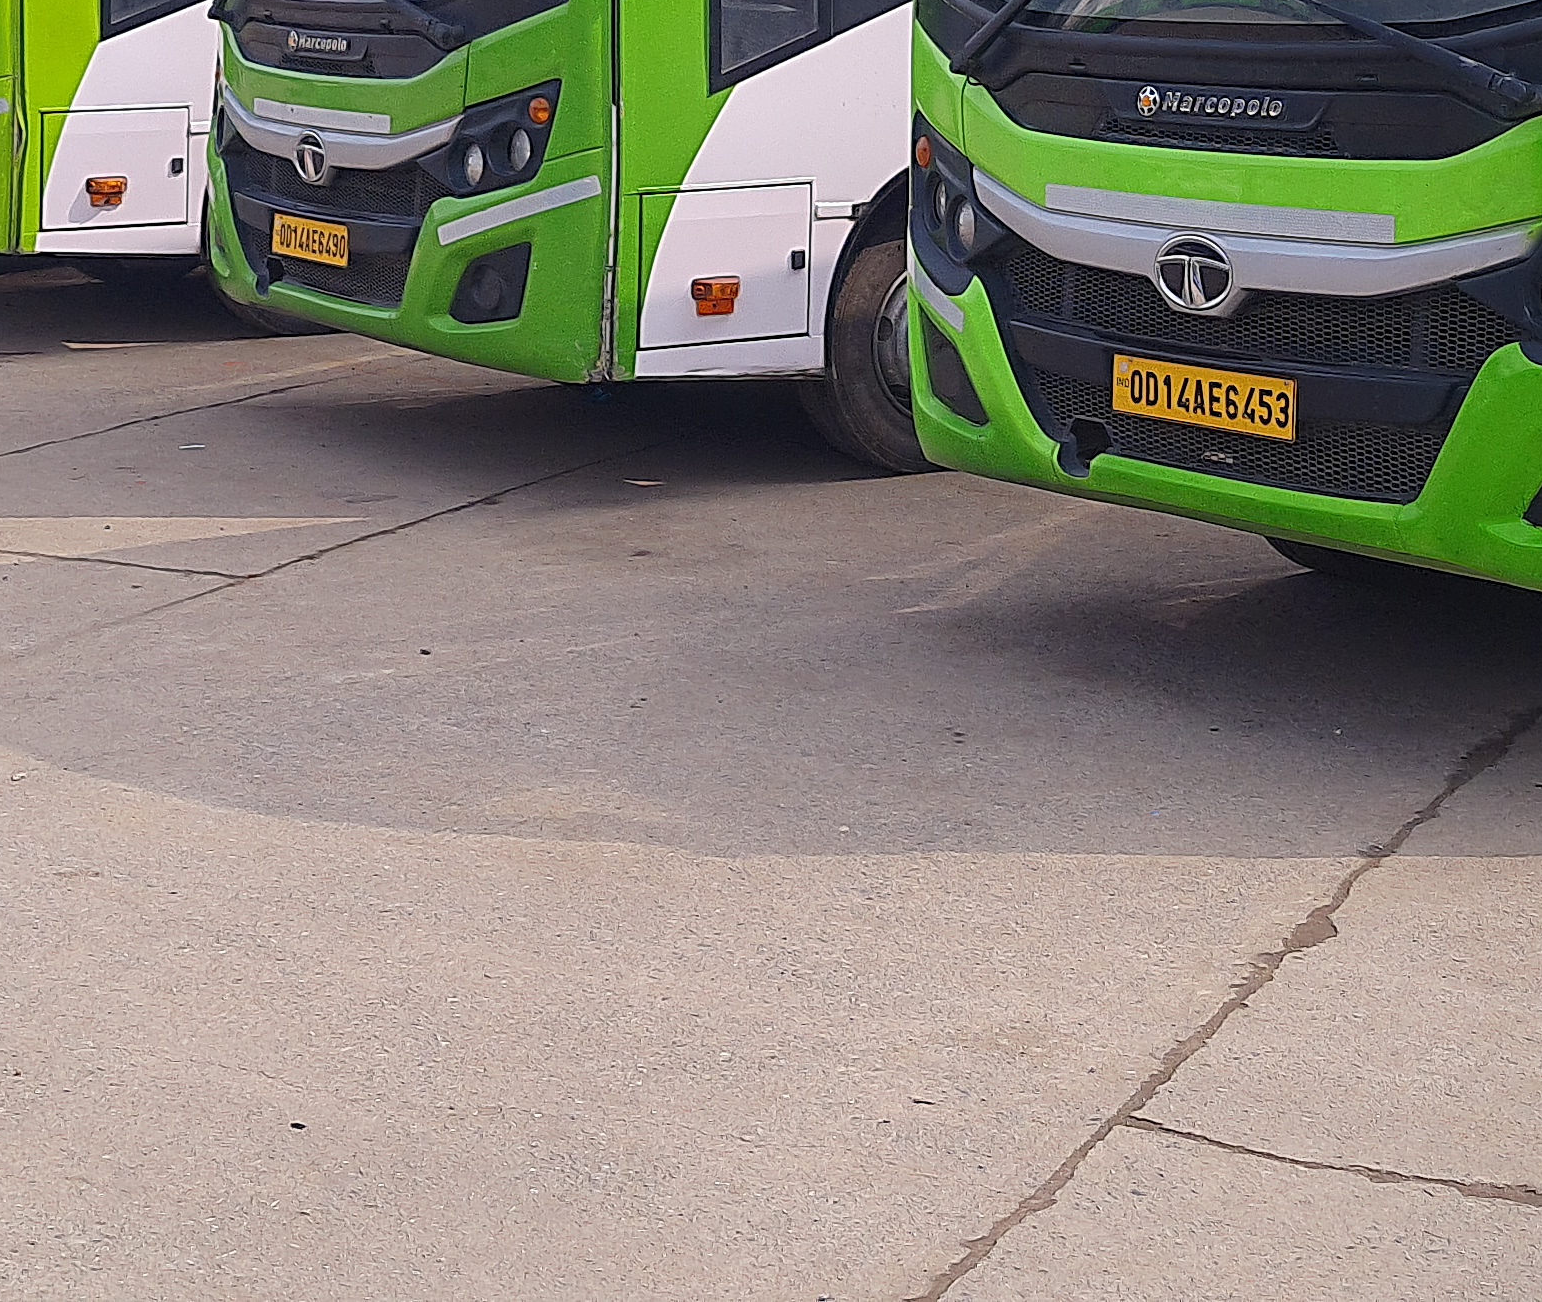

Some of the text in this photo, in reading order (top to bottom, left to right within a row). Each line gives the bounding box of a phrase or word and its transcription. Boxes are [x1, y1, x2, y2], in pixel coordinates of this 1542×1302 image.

[298, 35, 347, 52] Marcopolo
[1161, 91, 1283, 118] Marcopolo
[279, 223, 347, 259] OD14AE6490
[1130, 369, 1290, 429] OD14AE6453
